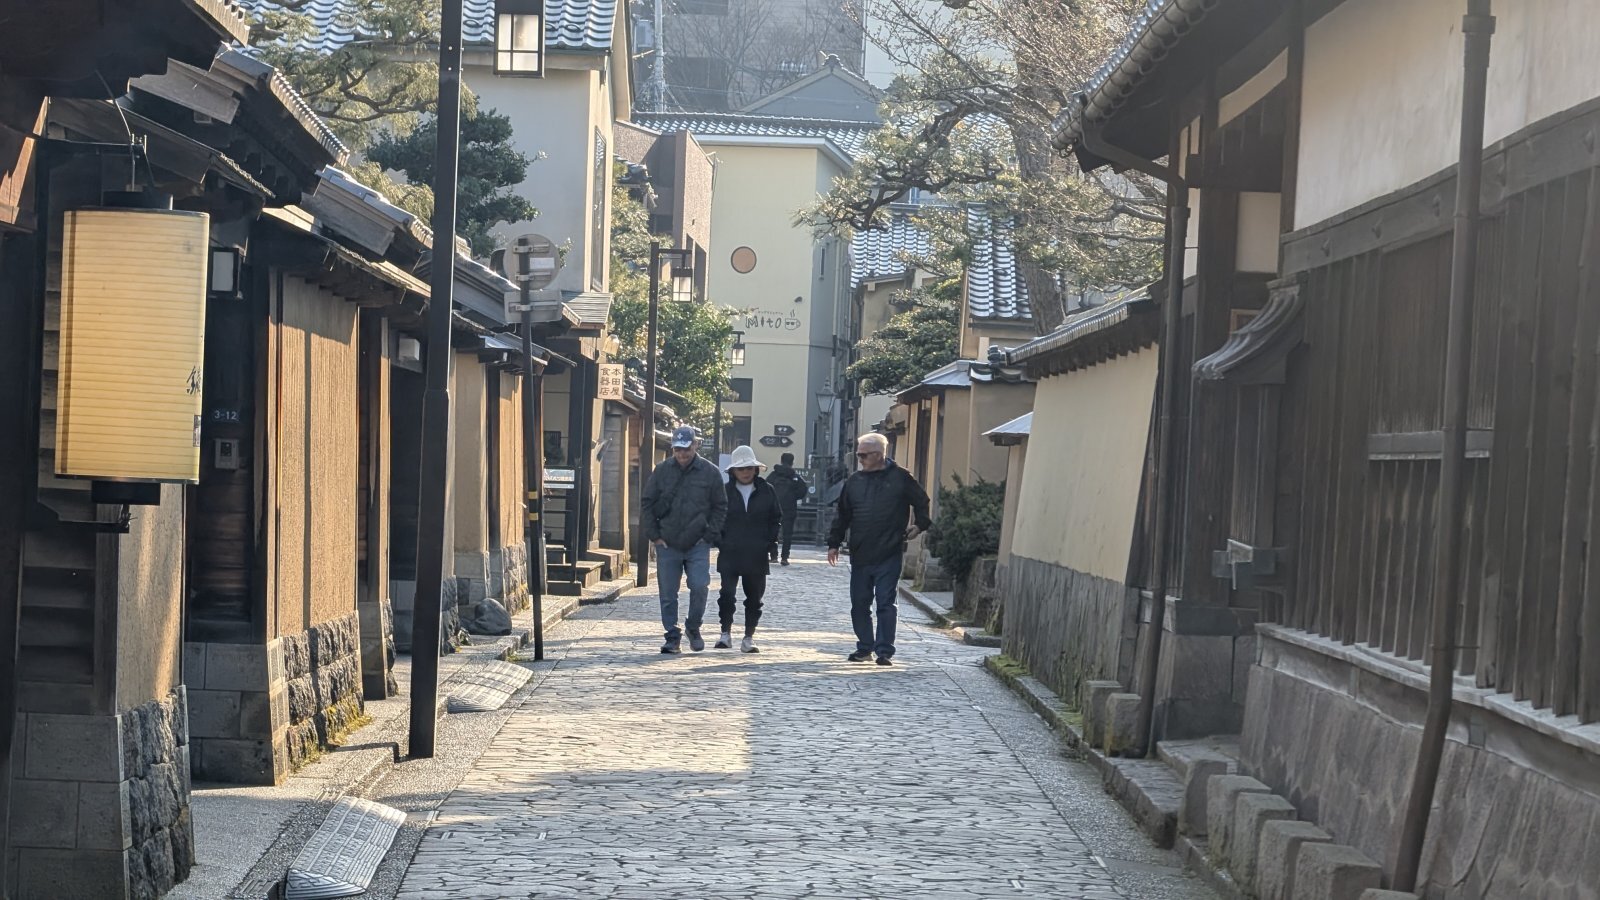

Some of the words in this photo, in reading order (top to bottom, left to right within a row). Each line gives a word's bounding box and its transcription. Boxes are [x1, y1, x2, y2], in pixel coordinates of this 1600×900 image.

[599, 367, 611, 396] 食器店
[610, 367, 622, 396] 本田屋
[214, 410, 237, 420] 3-12
